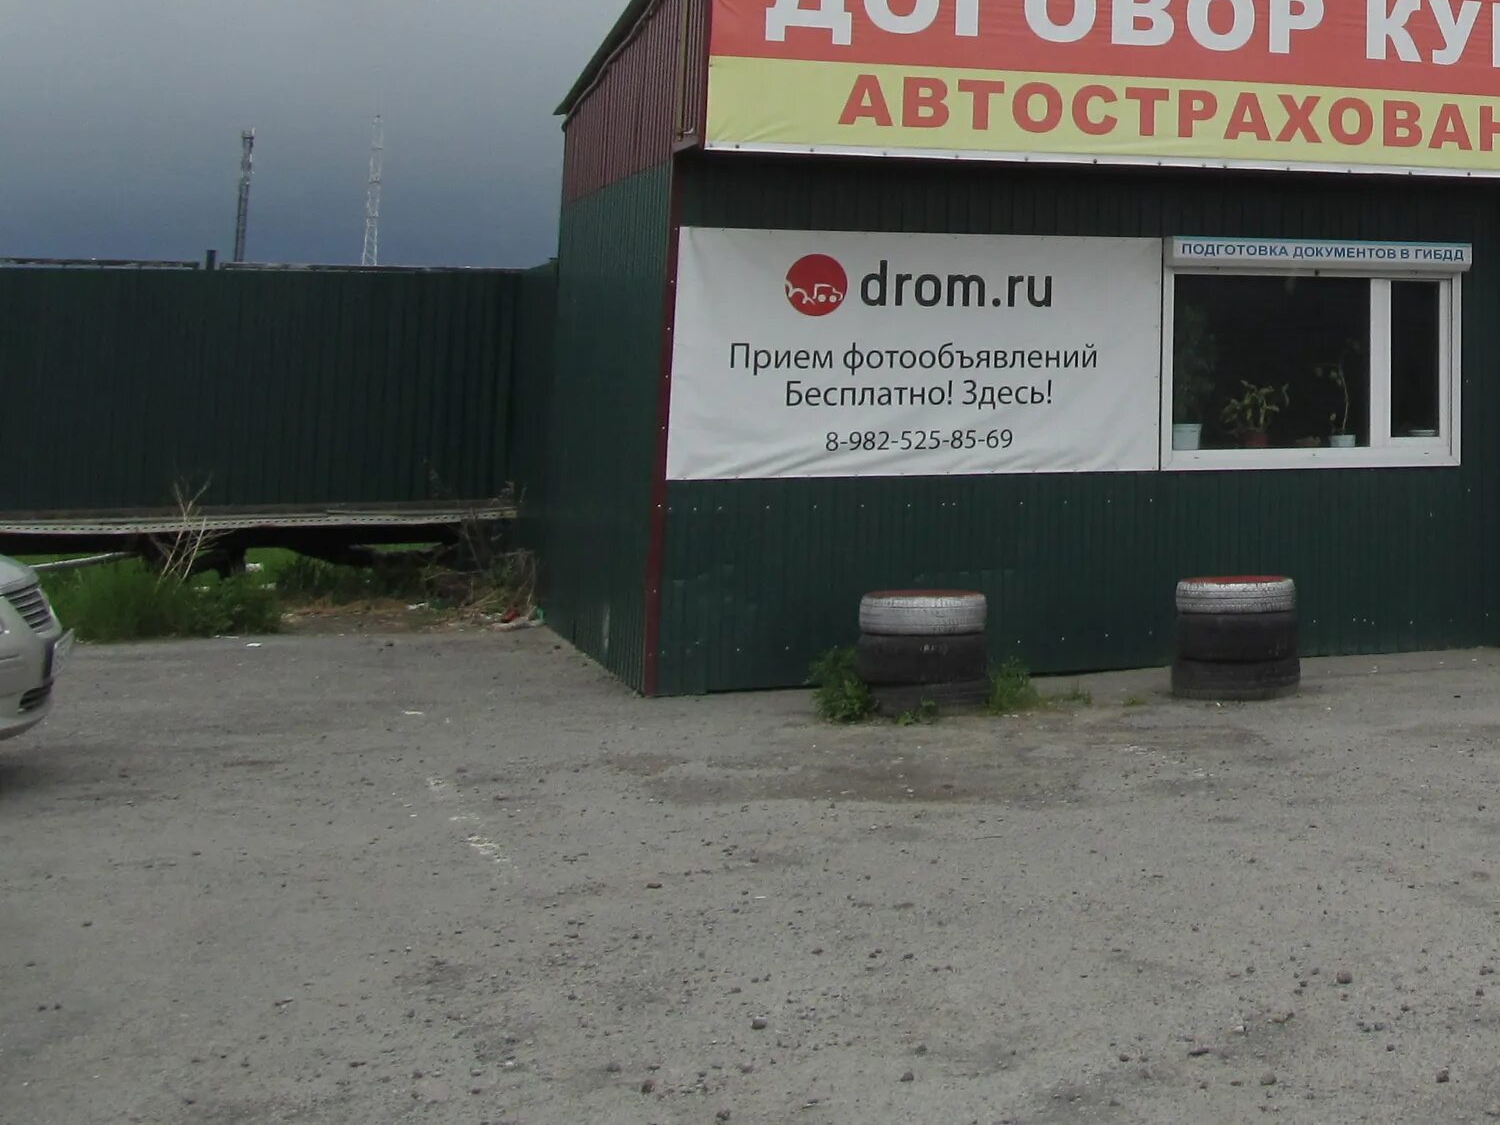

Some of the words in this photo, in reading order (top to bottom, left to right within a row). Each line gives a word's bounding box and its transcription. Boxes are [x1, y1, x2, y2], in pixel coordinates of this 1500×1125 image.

[1181, 243, 1289, 257] ПОДГОТОВКА
[1292, 246, 1397, 260] ДОКУМЕНТОВ
[1400, 249, 1410, 259] В
[1414, 249, 1465, 262] ГИБДД
[859, 259, 1054, 308] drom.ru
[729, 342, 834, 376] Прием
[842, 341, 1099, 376] фотообъявлений
[785, 380, 954, 408] Бесплатно!
[961, 379, 1054, 410] Здесь!
[825, 429, 1014, 452] 8-982-525-85-69
